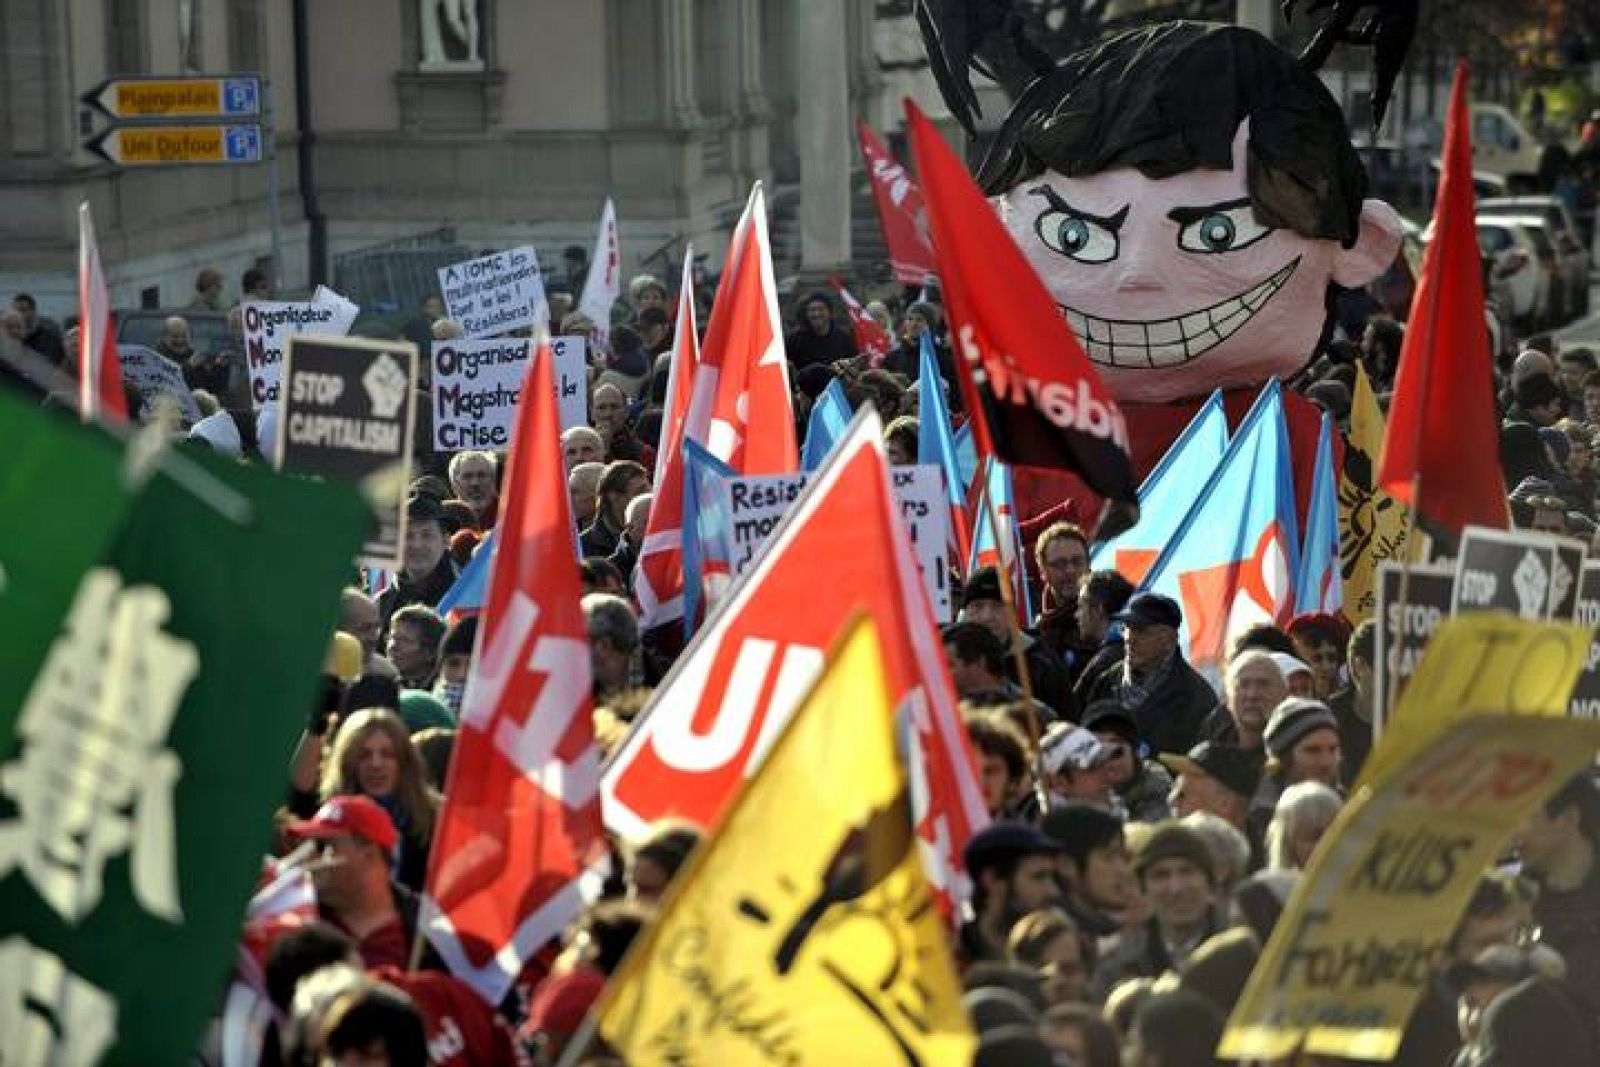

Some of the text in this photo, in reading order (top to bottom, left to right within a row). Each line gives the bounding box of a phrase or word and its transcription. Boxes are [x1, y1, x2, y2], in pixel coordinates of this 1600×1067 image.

[122, 133, 154, 152] Uni
[158, 132, 220, 153] Dufour
[292, 371, 345, 405] STOP
[289, 411, 400, 454] CAPITALISM
[437, 421, 507, 449] Crise
[1461, 571, 1498, 605] STOP
